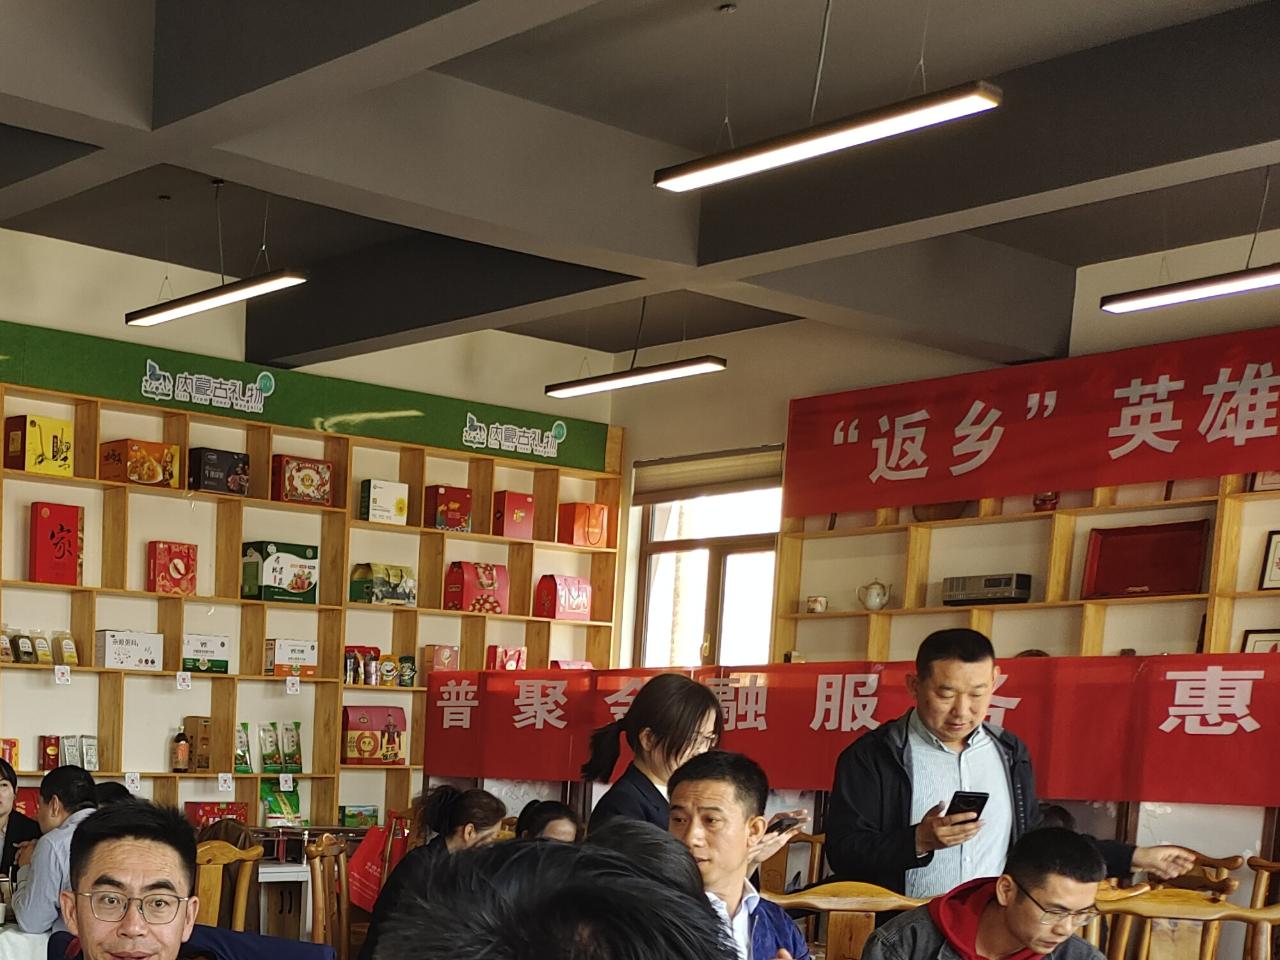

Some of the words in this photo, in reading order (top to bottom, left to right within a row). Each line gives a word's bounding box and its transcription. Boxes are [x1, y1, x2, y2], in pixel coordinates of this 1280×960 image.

[177, 374, 264, 405] 内蒙古礼物
[490, 425, 558, 450] 内蒙古礼物
[49, 523, 73, 560] 家
[1158, 665, 1265, 735] 惠
